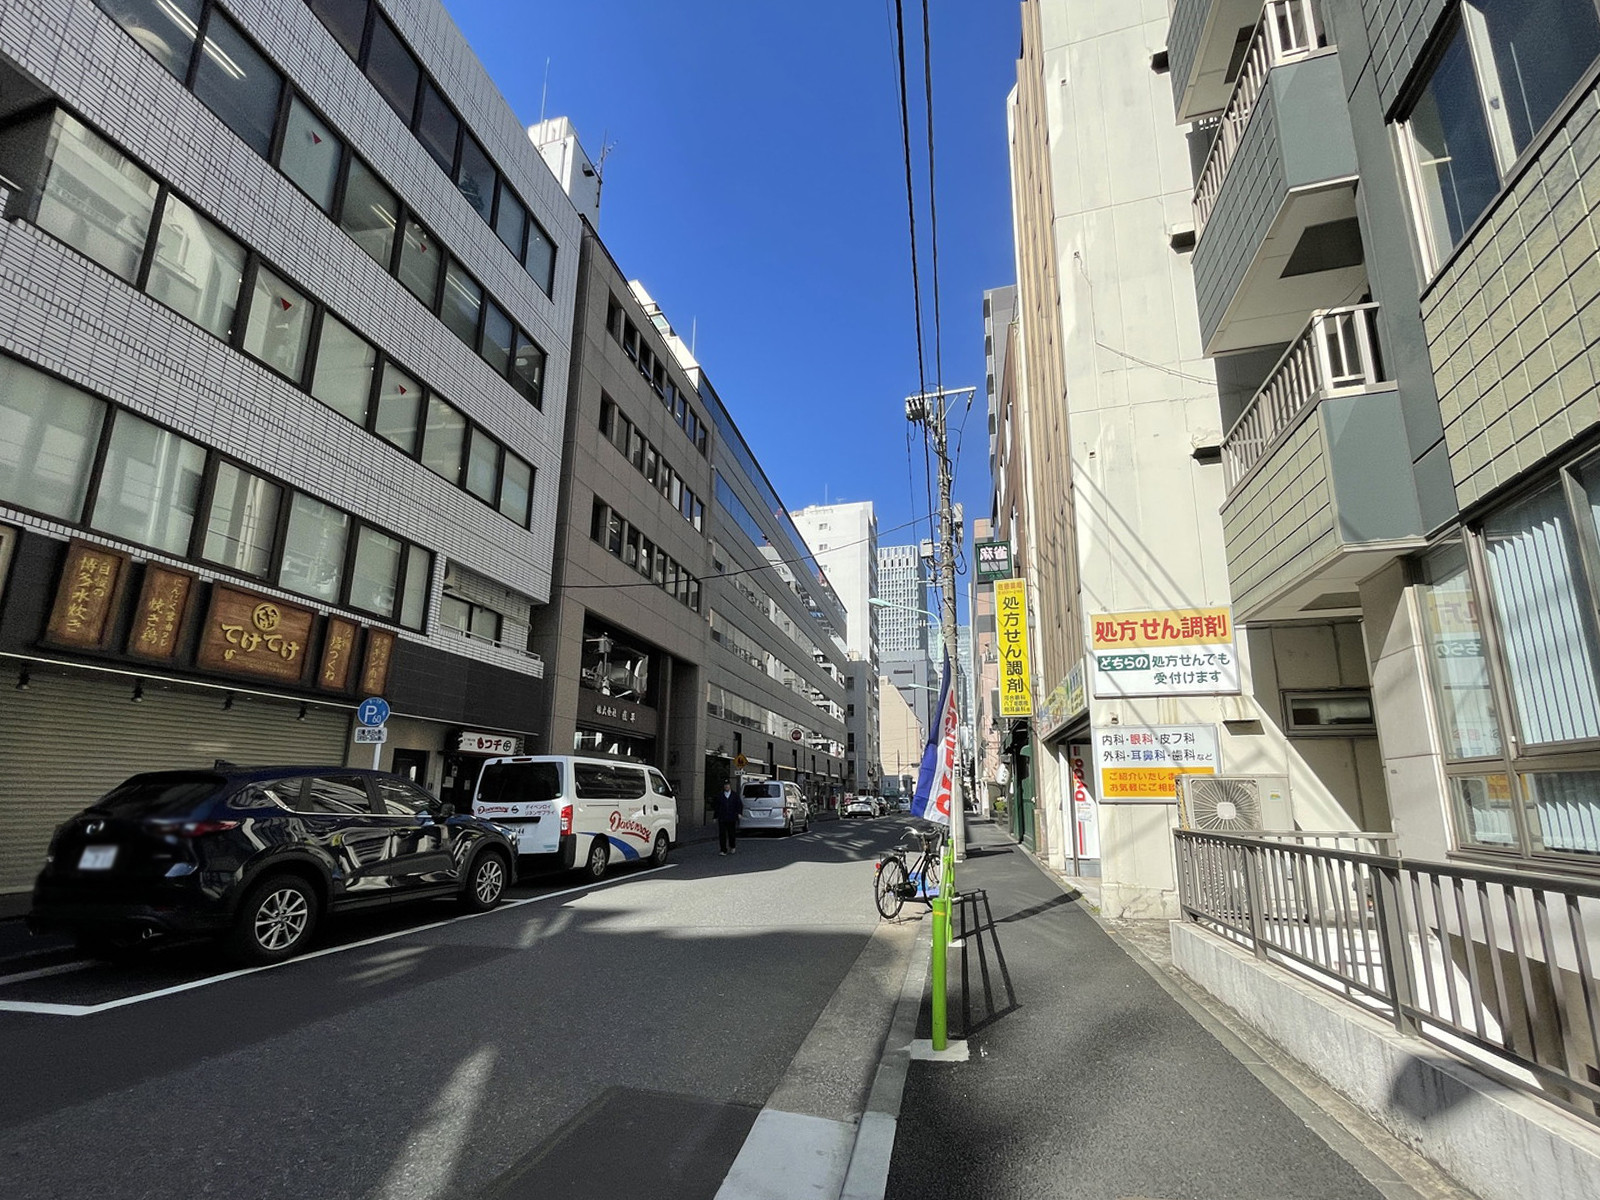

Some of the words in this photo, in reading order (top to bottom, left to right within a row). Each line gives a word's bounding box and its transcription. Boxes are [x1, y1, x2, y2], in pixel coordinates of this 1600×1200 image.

[980, 545, 1008, 561] 麻雀
[66, 557, 98, 633] 博多水炊き
[1094, 614, 1227, 643] 処方せん調剤
[221, 623, 300, 661] てけてけ
[1002, 596, 1024, 694] 処方せん調剤
[1100, 655, 1149, 670] どちらの
[1151, 652, 1231, 668] 処方せんでも
[1153, 670, 1222, 685] 受付けます
[364, 705, 378, 723] P
[372, 714, 382, 724] 60
[1102, 732, 1195, 746] 内科・眼科・皮フ科
[1103, 748, 1213, 762] 外科・耳鼻科・歯科など
[1073, 758, 1088, 802] DyDo
